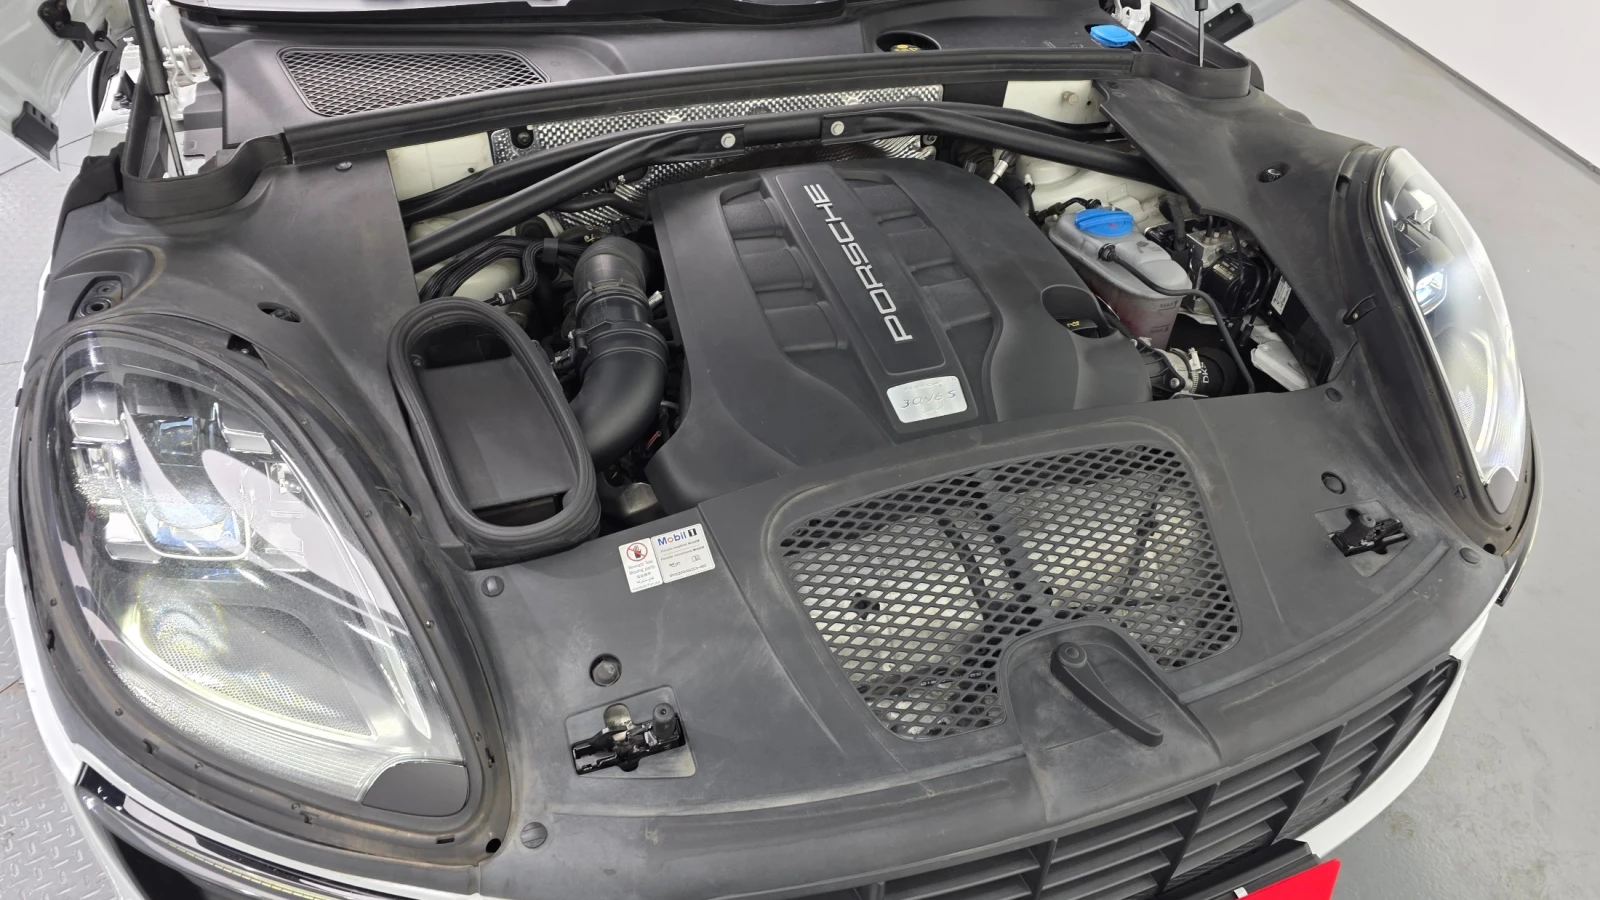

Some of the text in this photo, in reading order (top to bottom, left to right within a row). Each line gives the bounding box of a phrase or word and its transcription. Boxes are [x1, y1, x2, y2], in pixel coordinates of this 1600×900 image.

[803, 184, 913, 342] PORSCHE
[948, 390, 956, 398] S
[657, 531, 686, 546] Mobil
